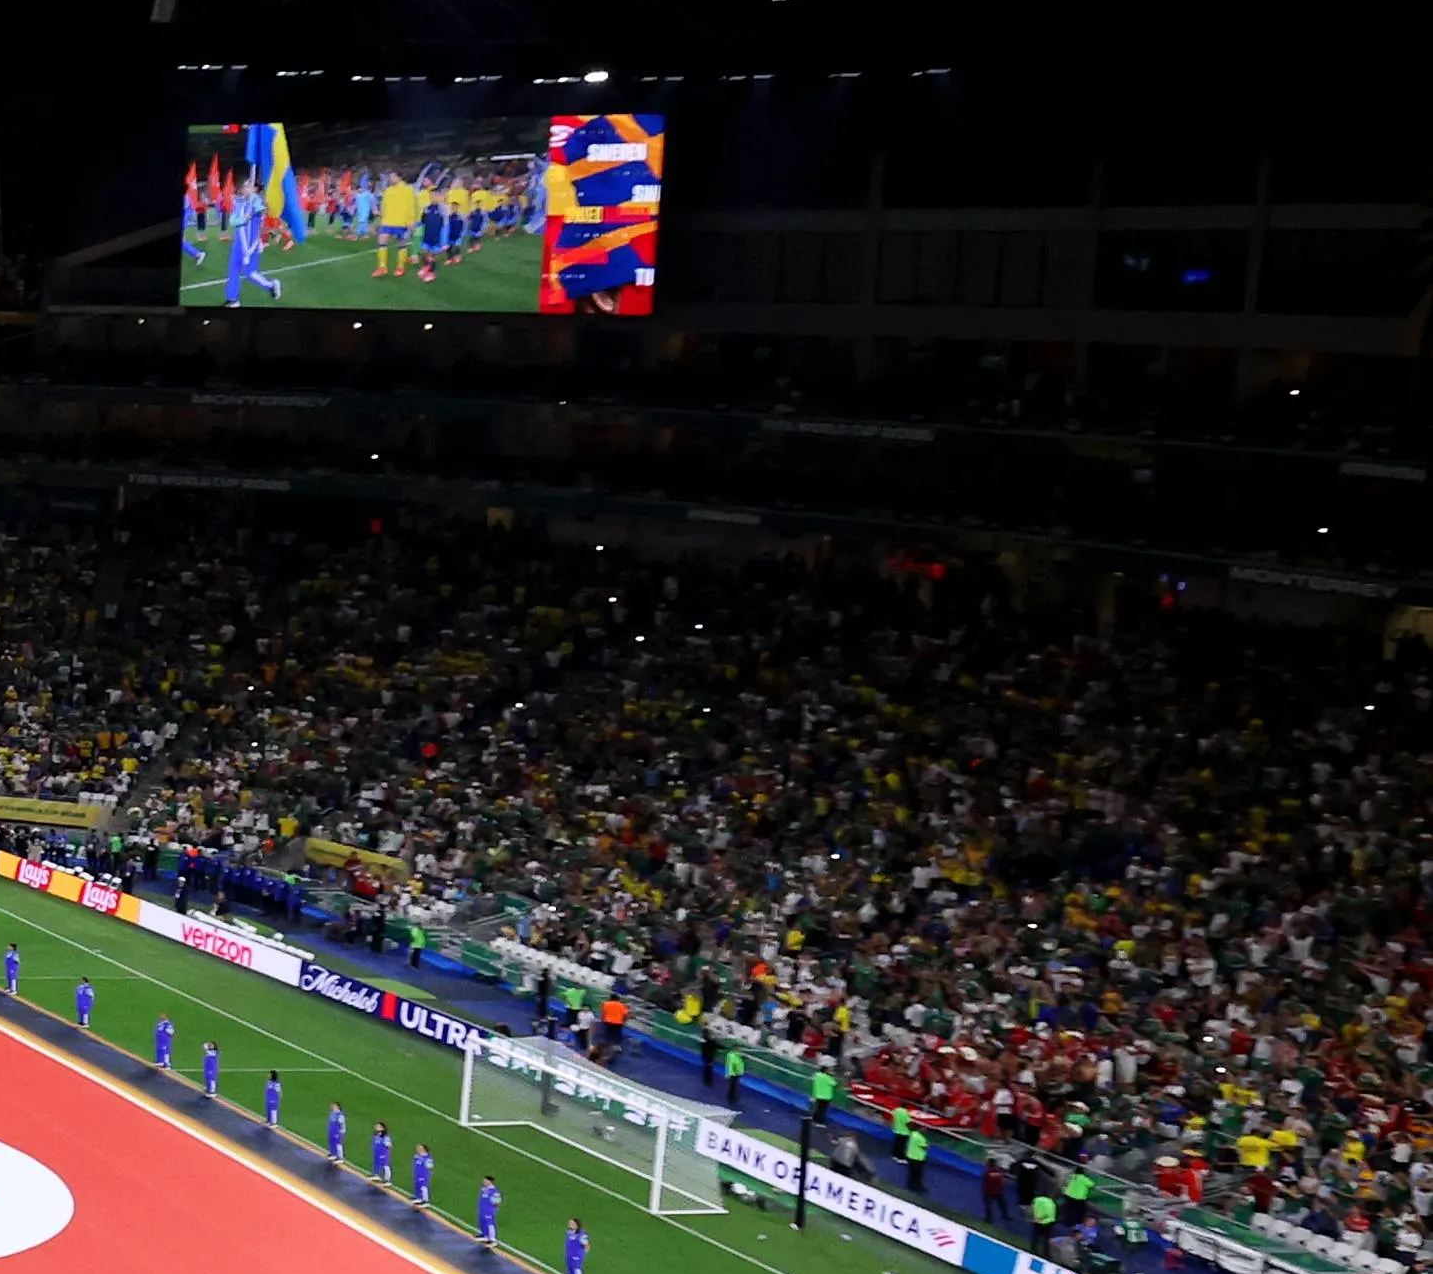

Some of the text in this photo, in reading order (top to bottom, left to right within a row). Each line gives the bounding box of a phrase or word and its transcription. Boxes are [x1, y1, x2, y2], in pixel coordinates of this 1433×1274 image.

[17, 860, 51, 889] Lay's
[83, 882, 120, 913] Lay's
[181, 922, 253, 968] verizon
[302, 962, 482, 1056] Michelob ULTRA
[704, 1130, 767, 1171] BANK
[807, 1174, 922, 1239] AMERICA
